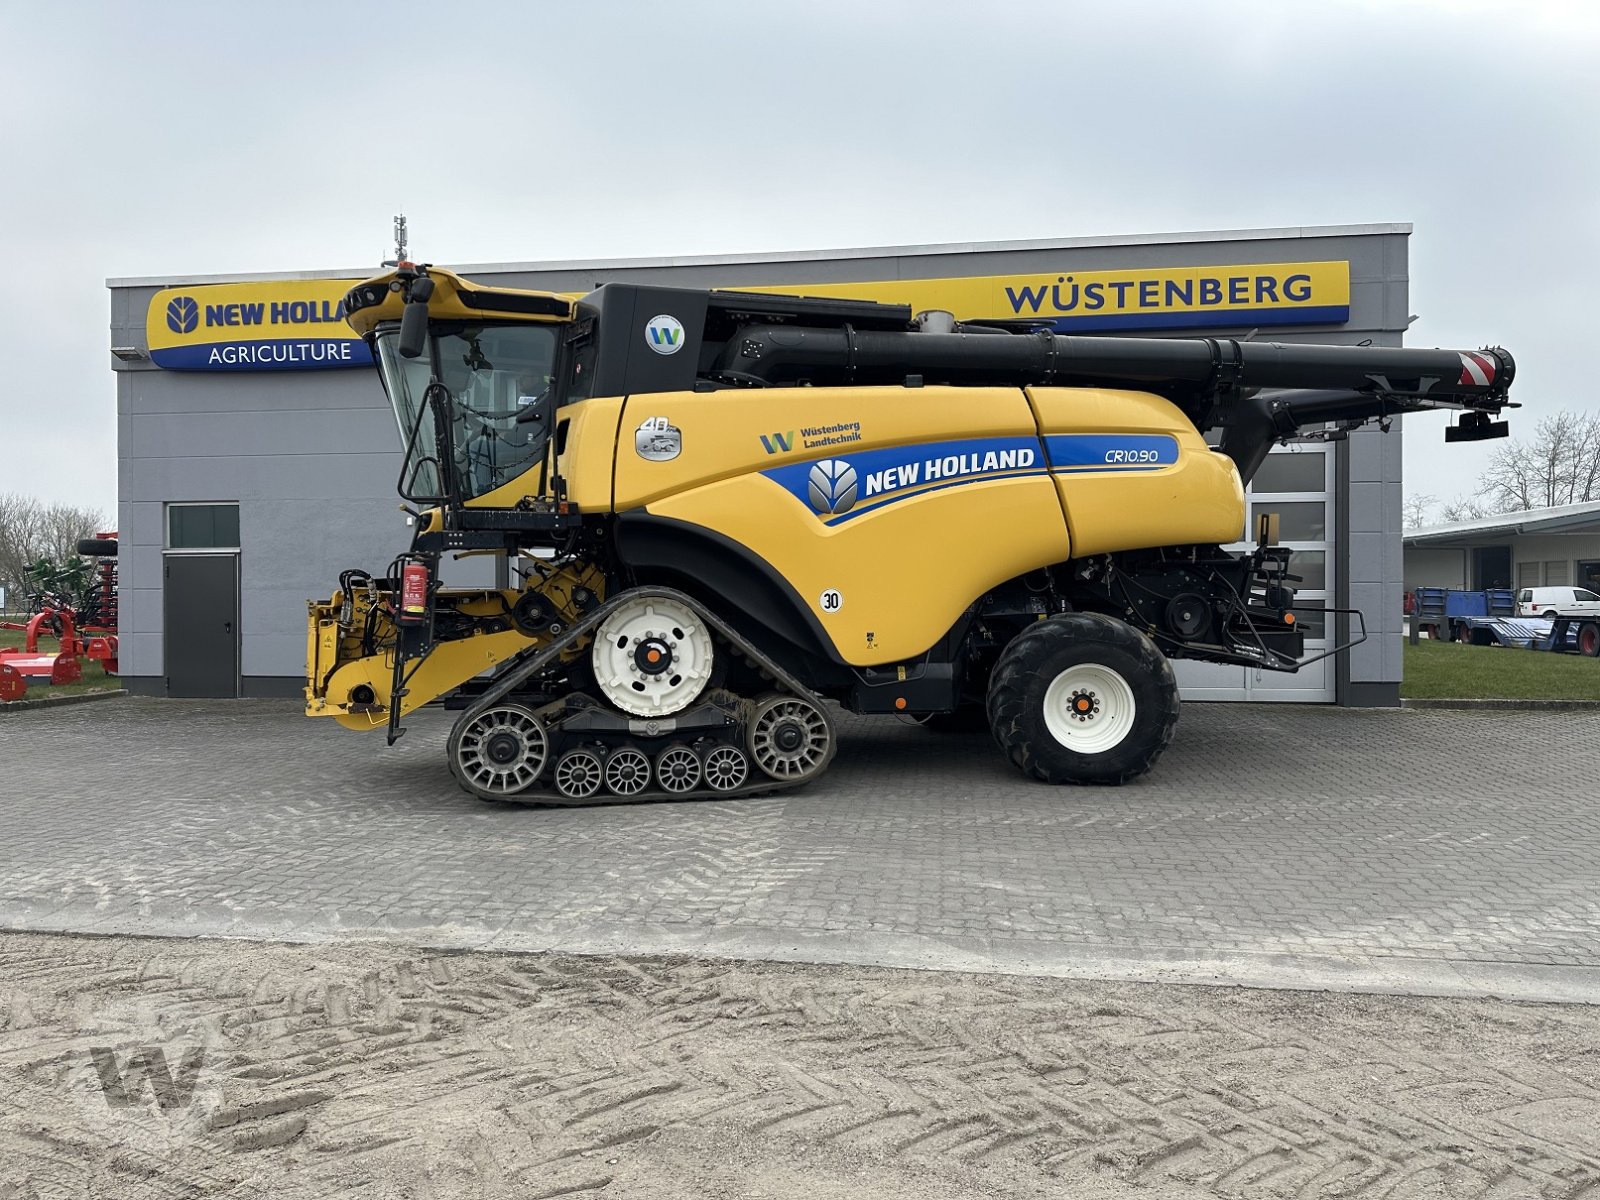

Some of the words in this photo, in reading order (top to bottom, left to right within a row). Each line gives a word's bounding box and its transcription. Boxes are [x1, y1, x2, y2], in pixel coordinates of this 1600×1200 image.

[1005, 275, 1311, 313] WÜSTENBERG
[206, 303, 264, 326] NEW
[271, 300, 344, 323] HOLLA
[650, 326, 680, 345] W
[208, 343, 351, 364] AGRICULTURE
[800, 422, 861, 438] Wüstenberg
[804, 432, 862, 449] Landtechnik
[1104, 449, 1159, 463] CR10.90
[866, 463, 920, 496] NEW
[924, 448, 1034, 481] HOLLAND
[824, 593, 839, 609] 30
